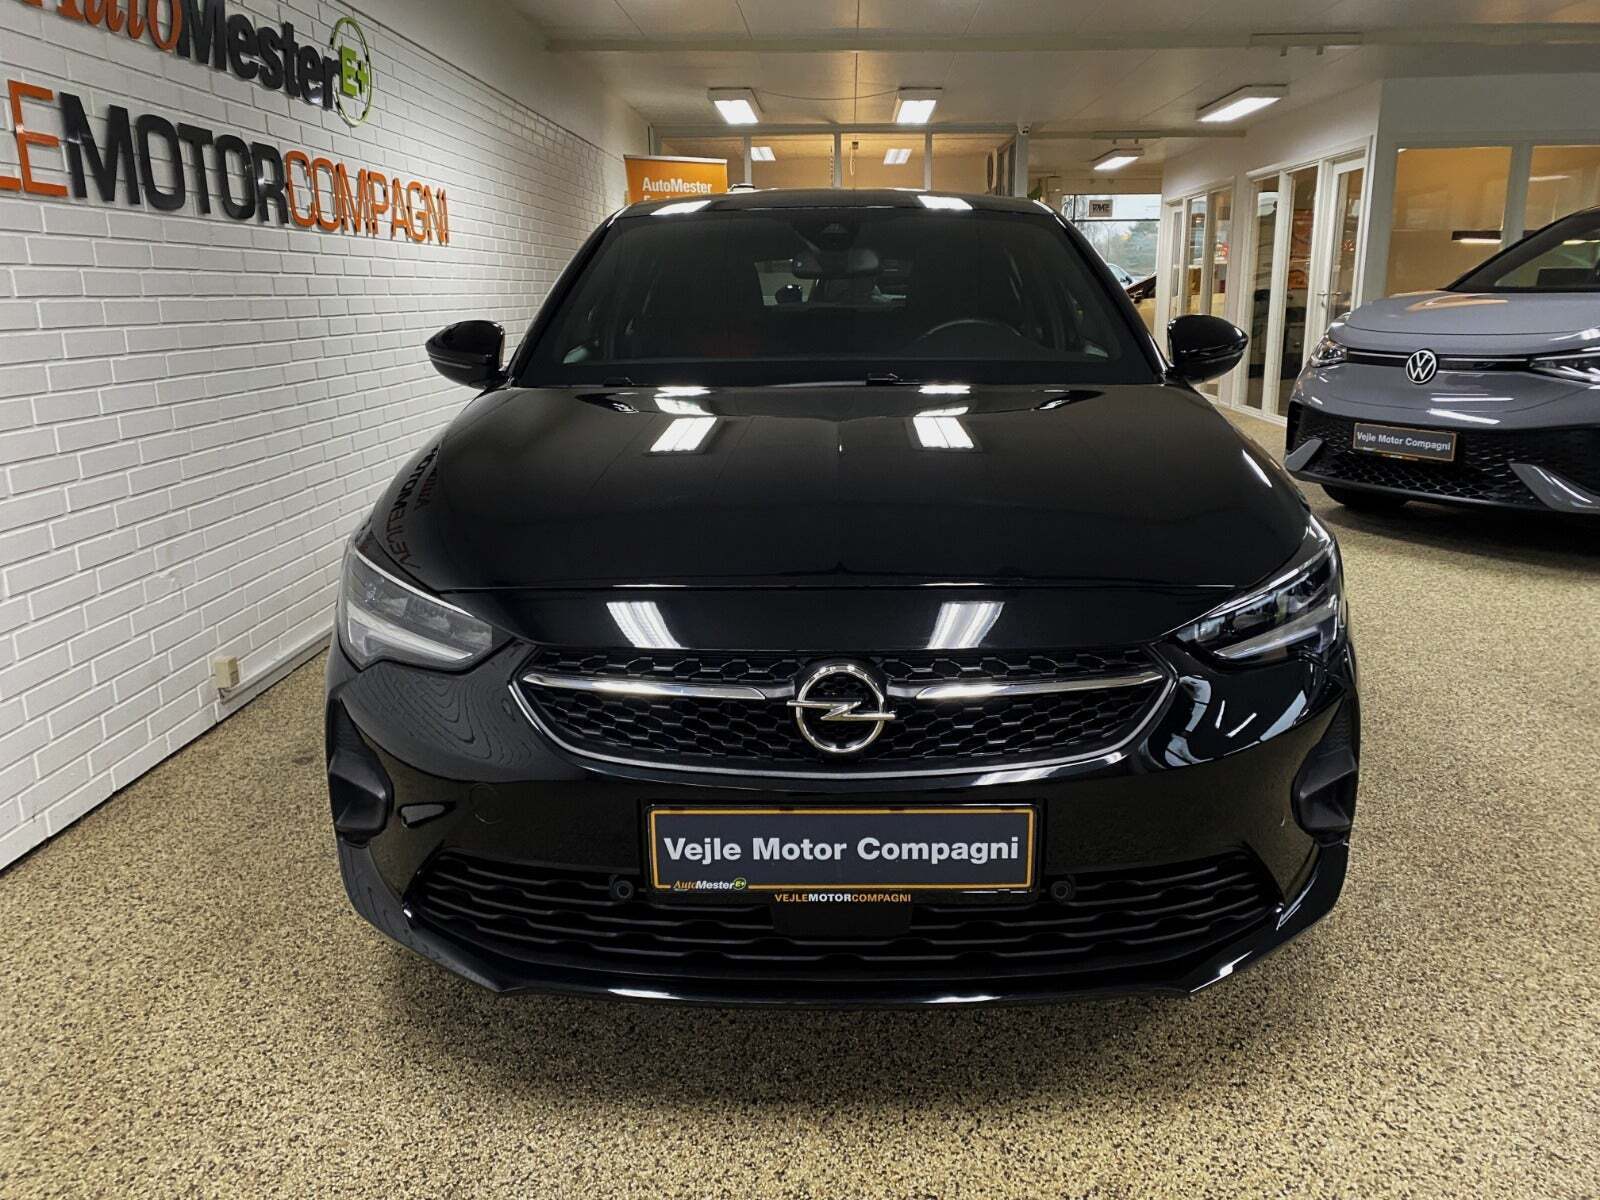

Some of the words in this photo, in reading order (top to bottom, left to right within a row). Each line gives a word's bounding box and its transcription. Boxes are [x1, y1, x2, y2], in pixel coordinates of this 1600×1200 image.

[18, 0, 341, 111] oMester
[642, 177, 712, 193] AutoMester
[1357, 432, 1376, 442] Vejle
[1379, 434, 1403, 445] Motor
[1405, 437, 1451, 451] Compagni
[664, 838, 742, 864] Vejle
[753, 838, 846, 861] Motor
[857, 837, 1019, 864] Compagni
[774, 893, 911, 902] VEJLEMOTORCOMPAGNI
